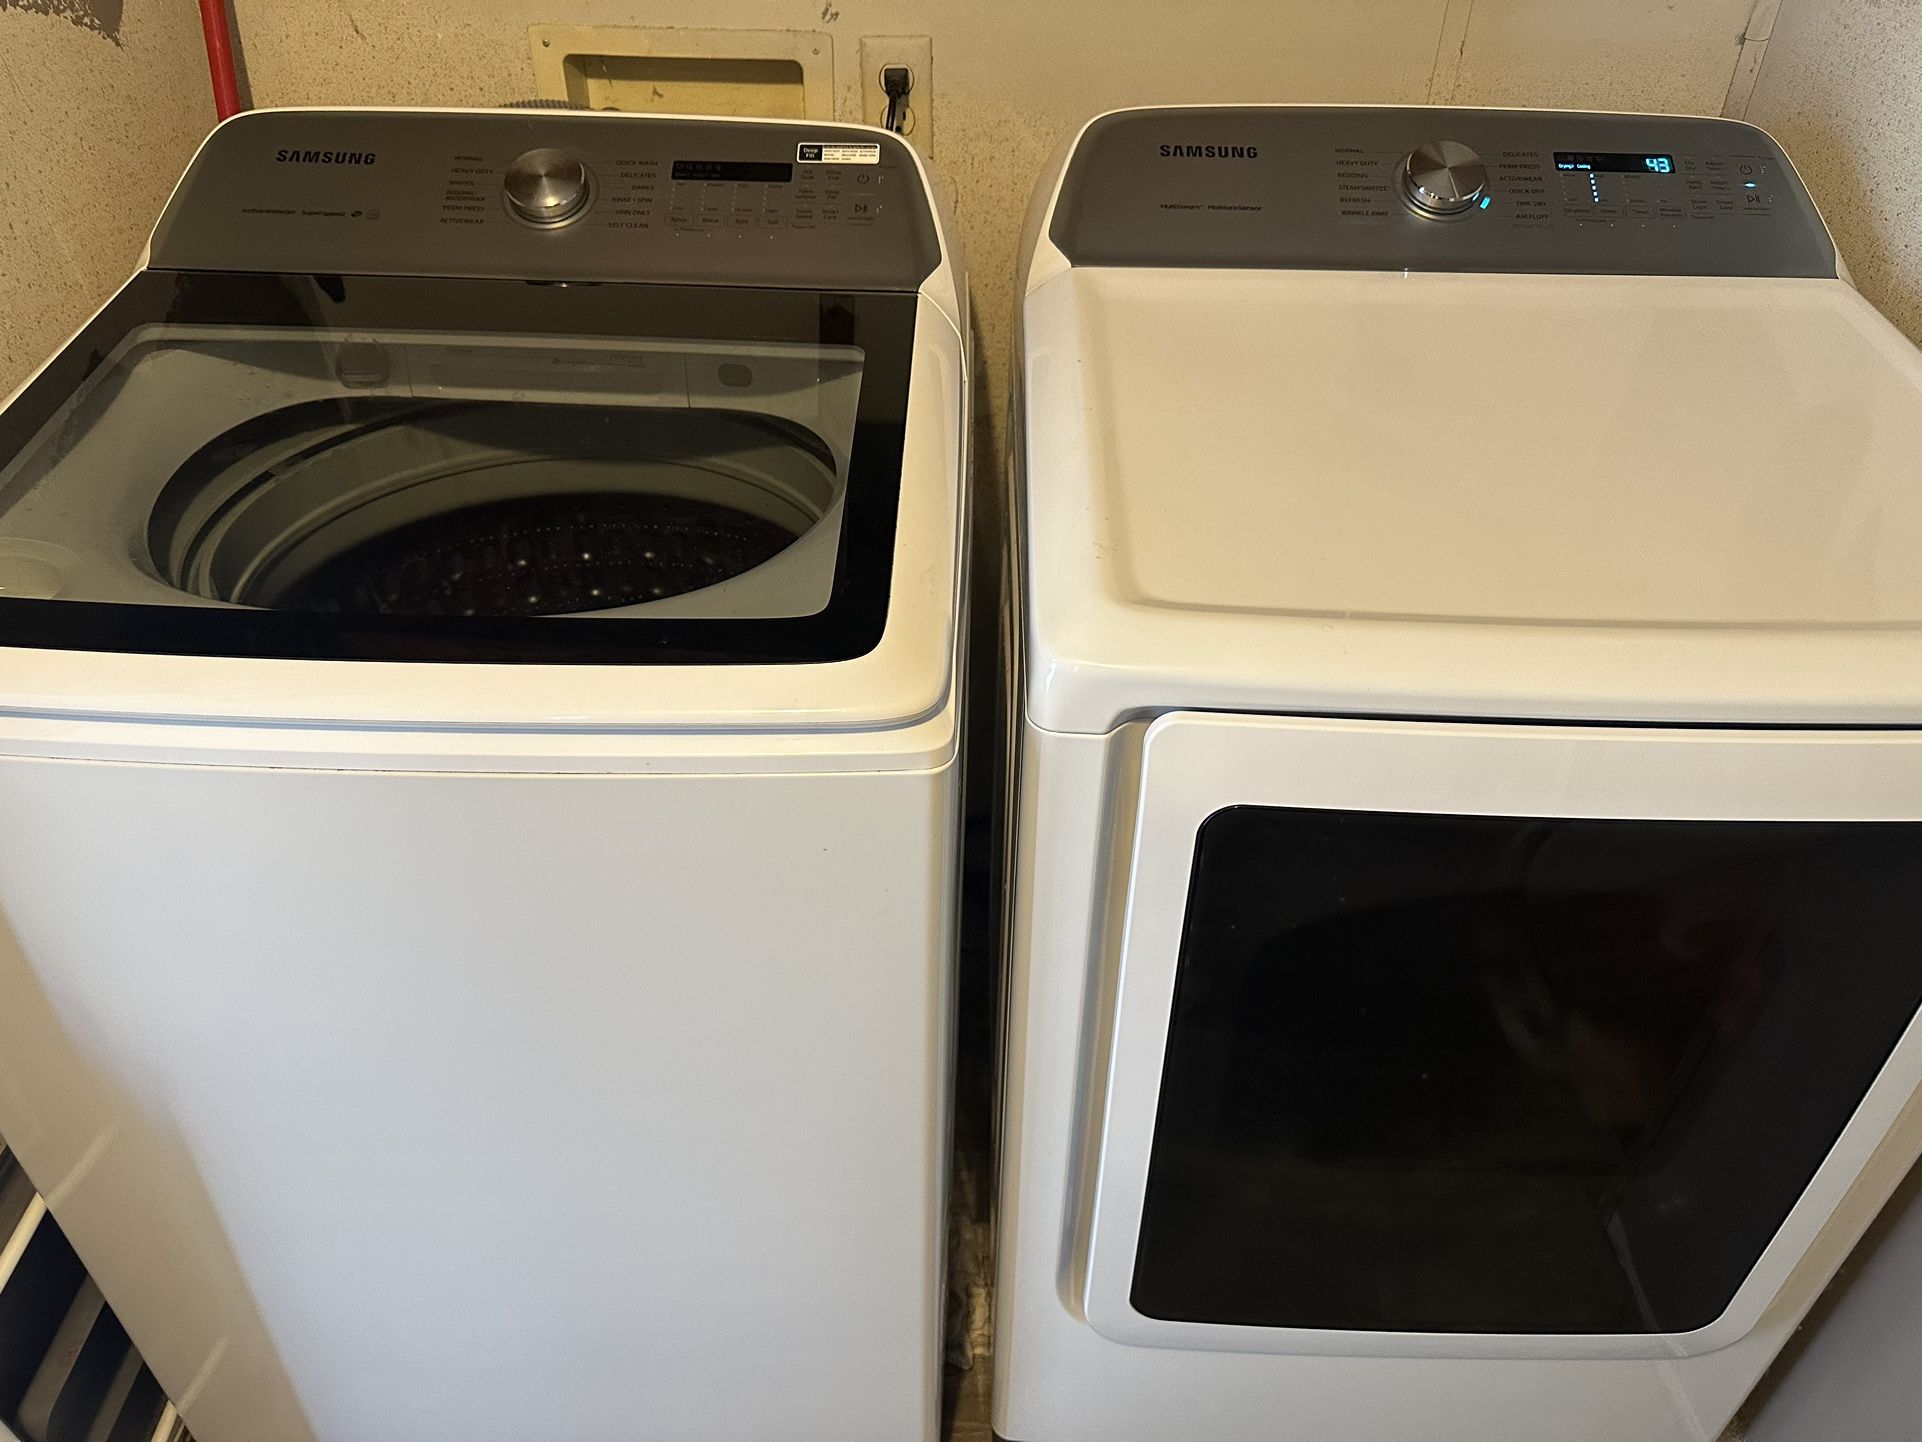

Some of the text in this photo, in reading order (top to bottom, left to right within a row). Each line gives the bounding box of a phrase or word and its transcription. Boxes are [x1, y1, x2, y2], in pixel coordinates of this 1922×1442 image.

[276, 149, 376, 165] SAMSUNG
[1159, 144, 1258, 159] SAMSUNG
[1645, 157, 1670, 173] 43
[632, 209, 650, 217] ONLY
